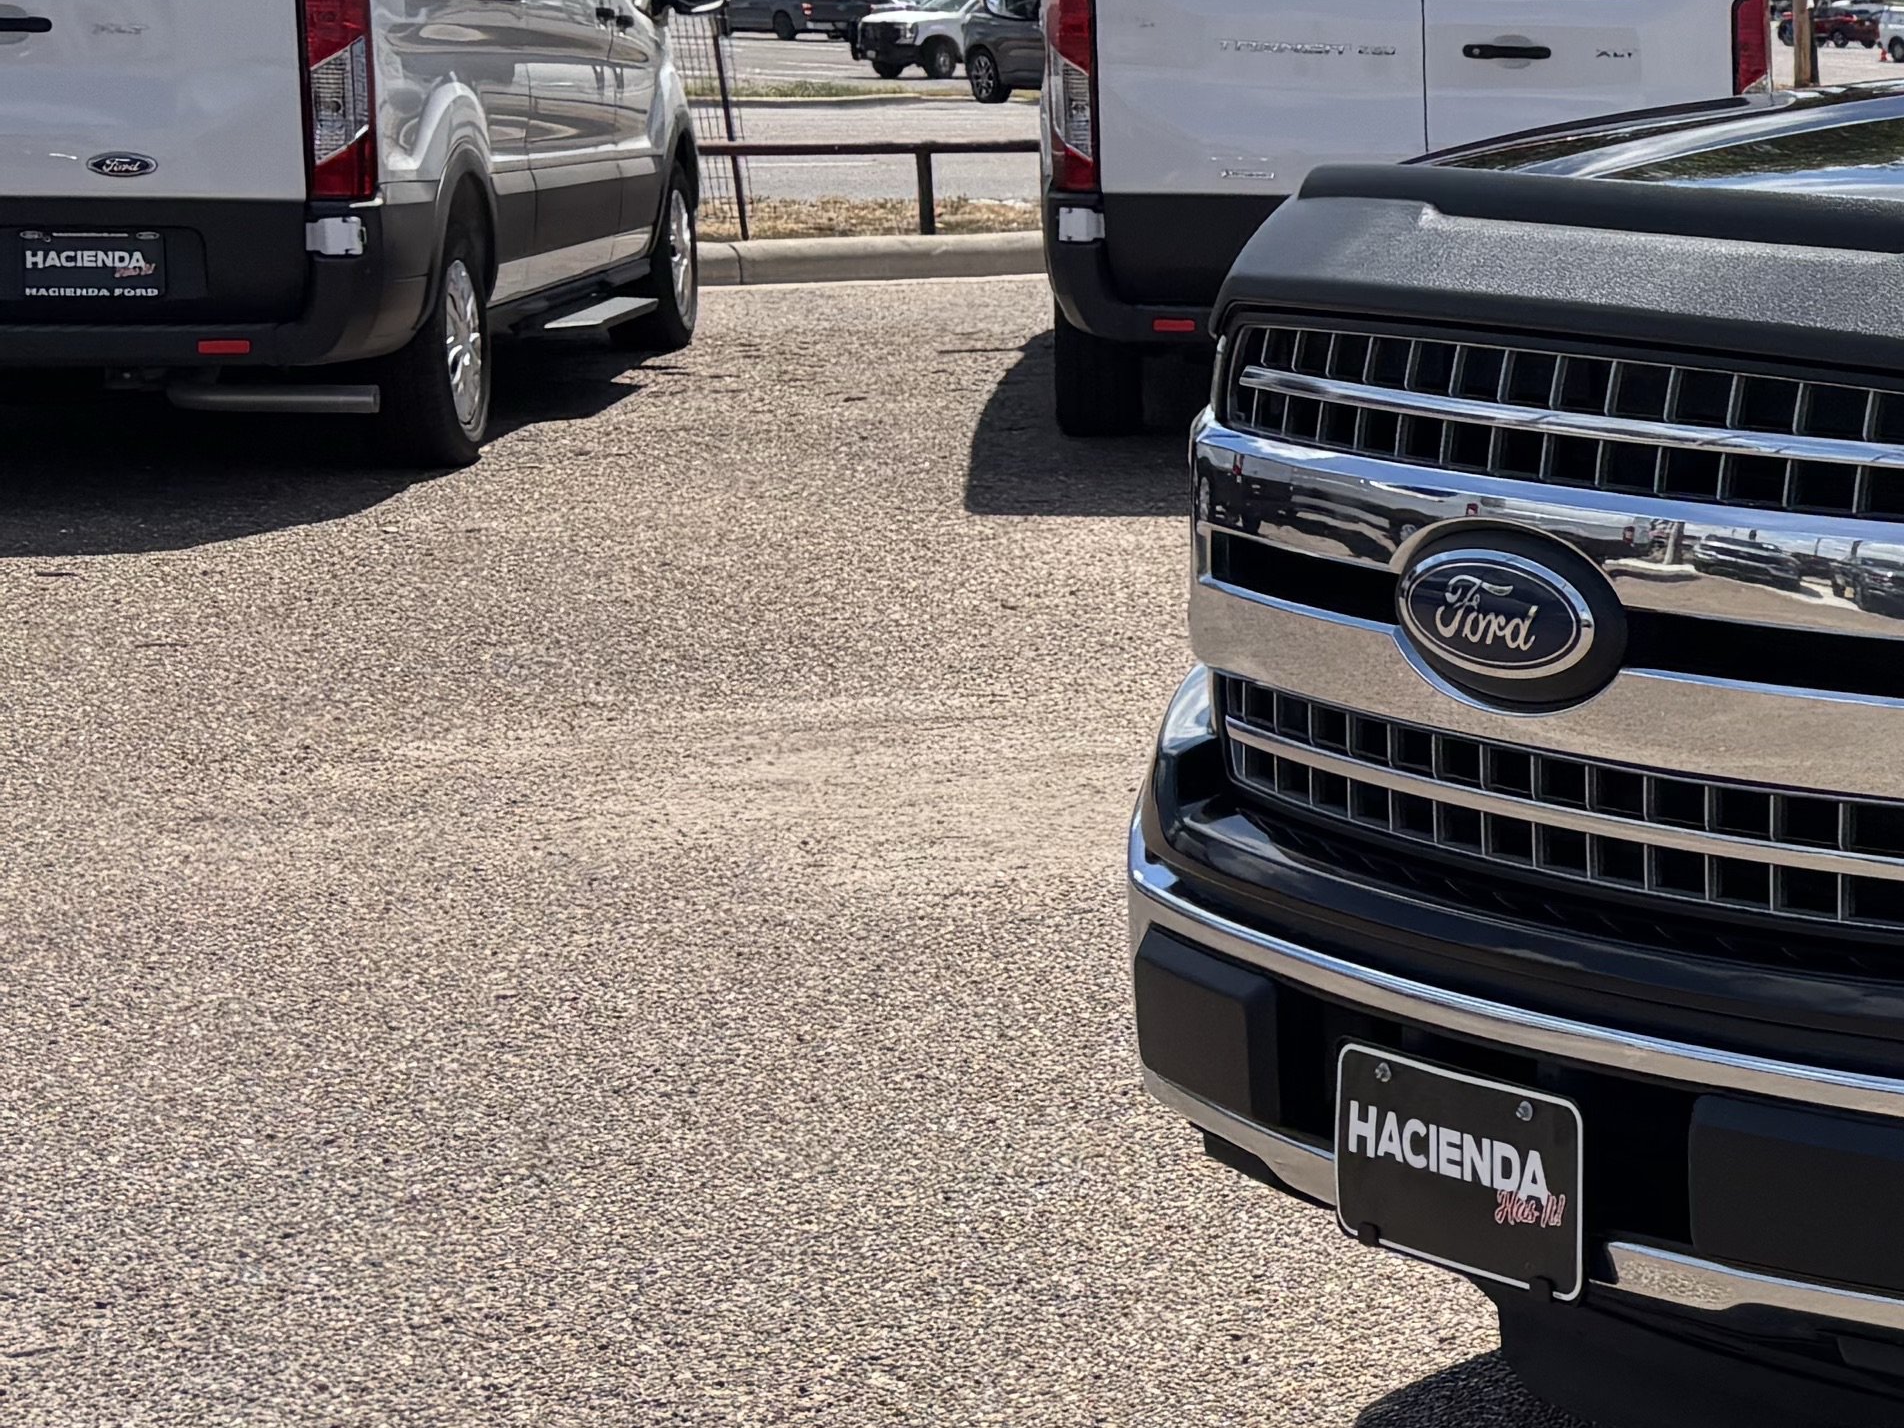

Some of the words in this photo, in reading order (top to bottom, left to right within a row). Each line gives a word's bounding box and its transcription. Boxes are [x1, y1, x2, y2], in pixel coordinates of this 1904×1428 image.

[25, 250, 145, 269] HACIENDA
[25, 287, 110, 297] HACIENDA
[113, 287, 159, 297] FORD
[1435, 574, 1539, 651] Ford
[1348, 1100, 1549, 1207] HACIENDA
